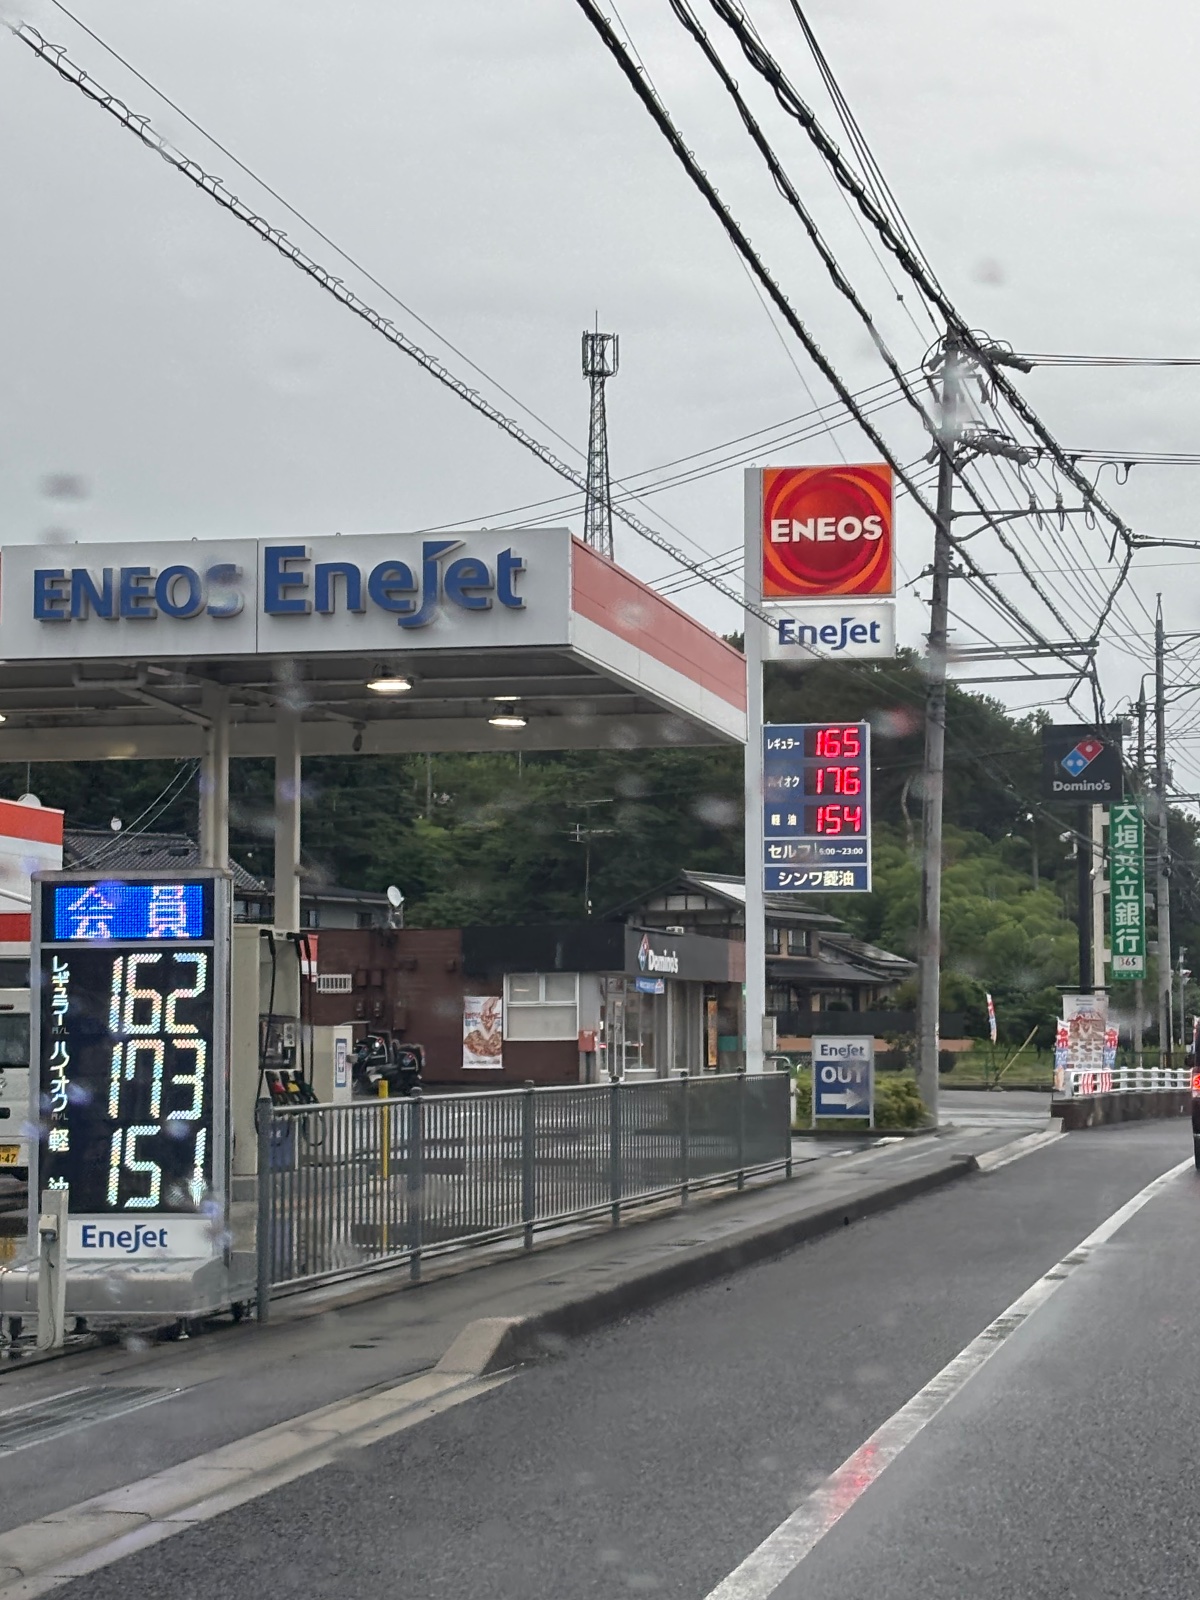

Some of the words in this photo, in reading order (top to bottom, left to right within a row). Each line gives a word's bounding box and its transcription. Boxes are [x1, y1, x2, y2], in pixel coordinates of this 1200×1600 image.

[770, 515, 883, 543] ENEOS
[33, 563, 243, 621] ENEOS
[767, 738, 800, 750] レギュラー
[815, 728, 860, 757] 165
[816, 766, 860, 795] 176
[1052, 779, 1111, 791] Domino's
[816, 804, 862, 835] 154
[1114, 799, 1141, 954] 大垣共立銀行
[68, 884, 190, 938] 会員
[51, 955, 70, 1026] レギュラー
[108, 952, 208, 1034] 162
[50, 1041, 70, 1113] ハイオク
[107, 1038, 207, 1121] 173
[821, 1066, 867, 1084] OUT
[106, 1125, 207, 1208] 151
